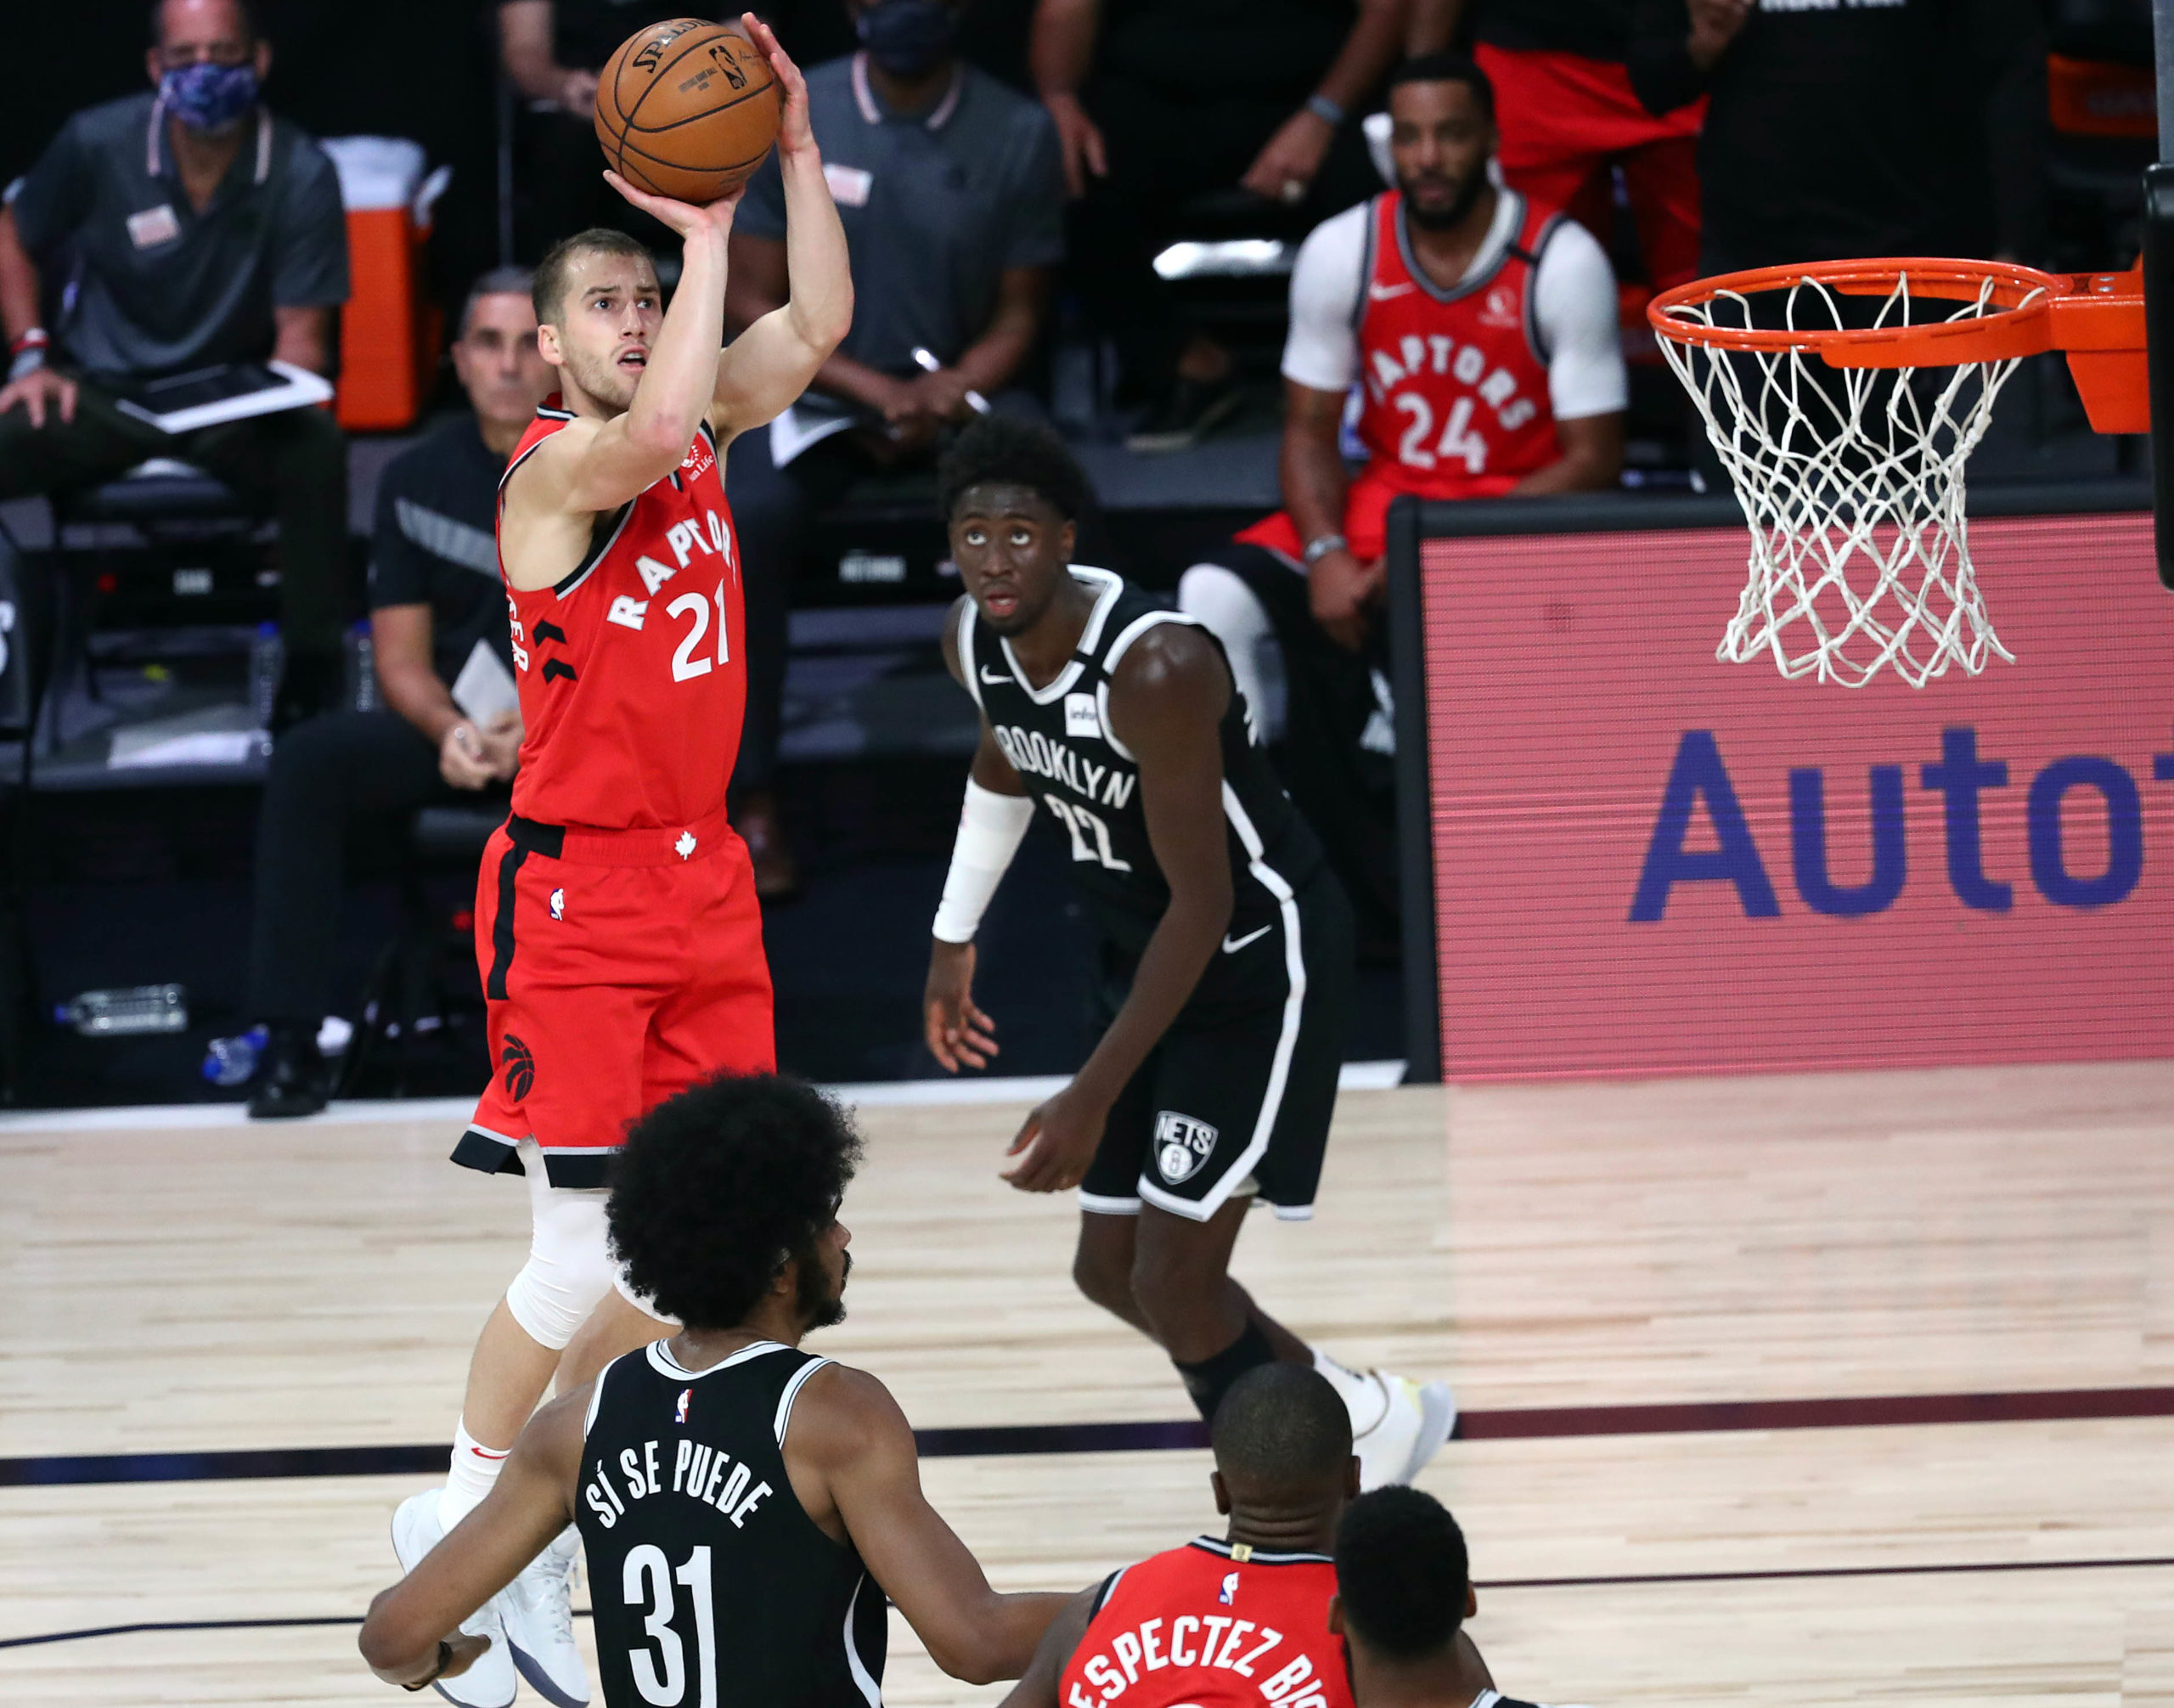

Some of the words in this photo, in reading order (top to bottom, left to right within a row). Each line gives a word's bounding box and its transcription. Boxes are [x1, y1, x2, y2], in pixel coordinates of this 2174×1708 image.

[696, 454, 714, 473] Life
[1394, 391, 1488, 475] 24
[606, 509, 737, 630] RAPTOR
[665, 578, 729, 683] 21
[1044, 792, 1134, 873] 22
[1626, 726, 2174, 923] Auto
[1156, 1114, 1212, 1155] NETS
[585, 1459, 626, 1529] SÍ
[619, 1440, 662, 1500] SE
[673, 1439, 774, 1529] PUEDE
[622, 1543, 718, 1708] 31
